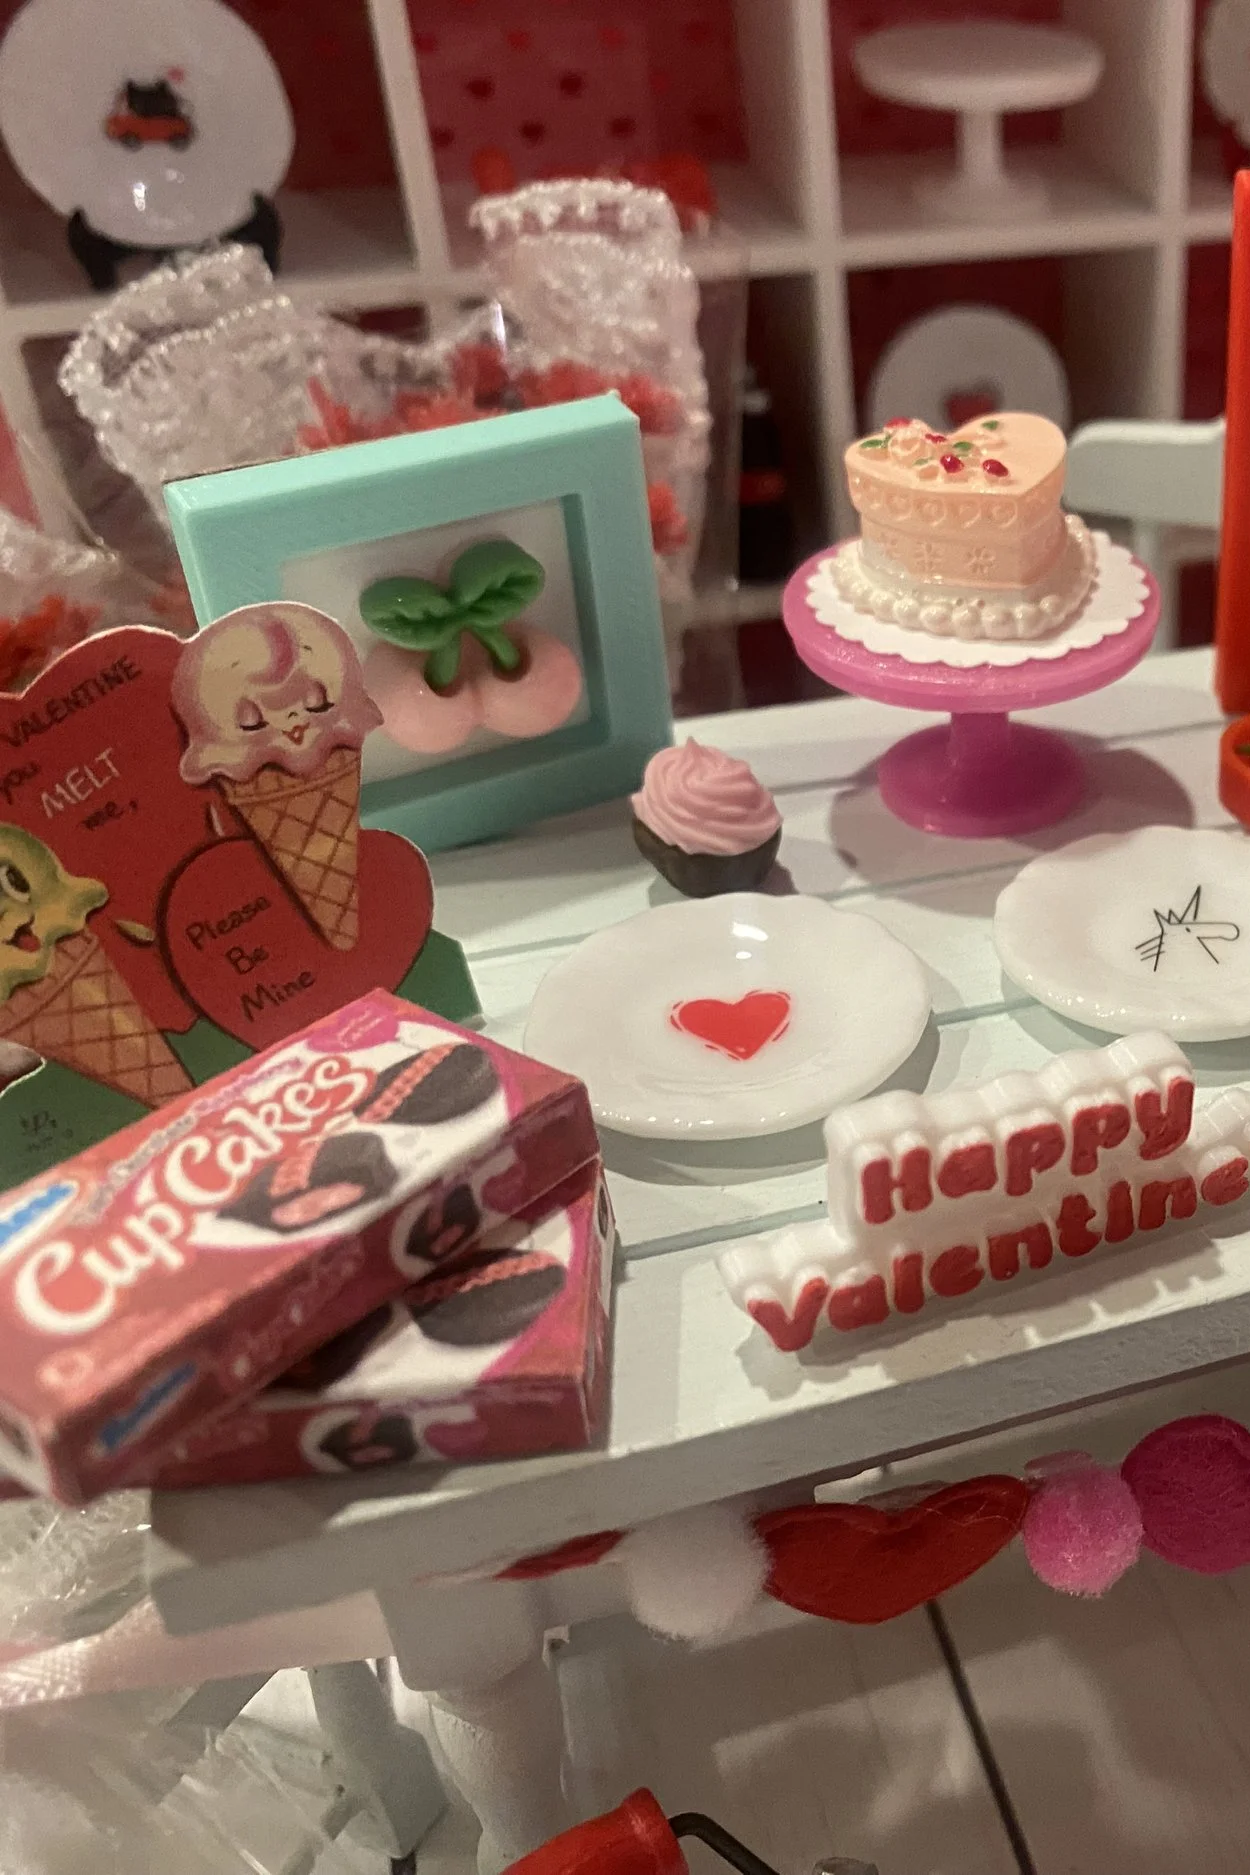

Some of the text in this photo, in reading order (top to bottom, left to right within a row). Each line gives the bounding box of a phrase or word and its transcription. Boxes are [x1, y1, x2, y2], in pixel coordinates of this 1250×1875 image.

[0, 655, 142, 747] VALENTINE
[41, 748, 120, 819] MELT
[225, 946, 270, 975] Be
[241, 971, 316, 1023] Mine
[861, 1076, 1196, 1225] Happy
